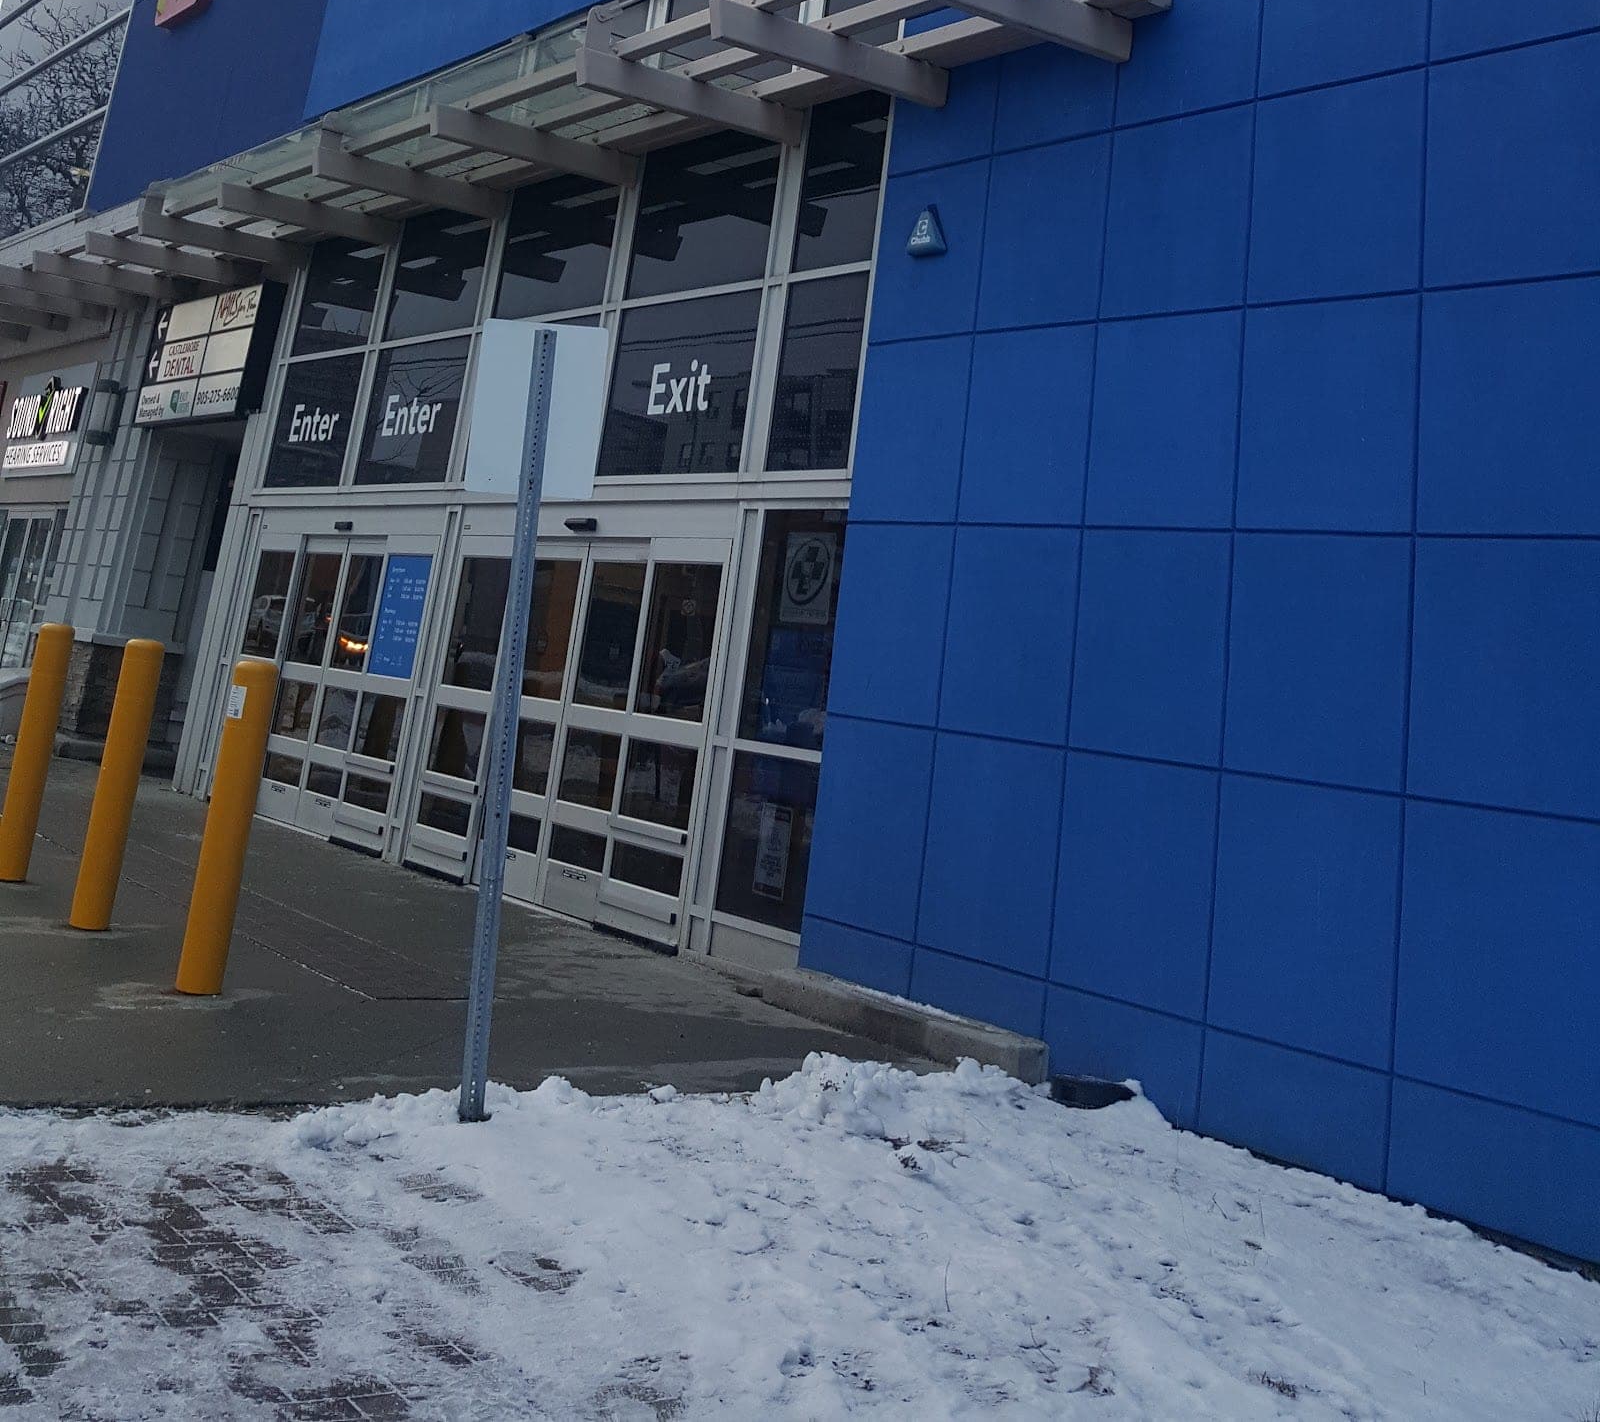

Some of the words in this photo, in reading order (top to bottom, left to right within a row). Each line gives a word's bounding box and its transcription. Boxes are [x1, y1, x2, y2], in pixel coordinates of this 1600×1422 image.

[163, 355, 195, 378] DENTAL
[646, 359, 711, 416] Exit
[6, 394, 42, 439] SOUND
[45, 386, 83, 434] RIGHT
[288, 403, 339, 443] Enter
[380, 394, 442, 438] Enter
[3, 446, 33, 467] HEARING
[31, 442, 63, 464] SERVICES
